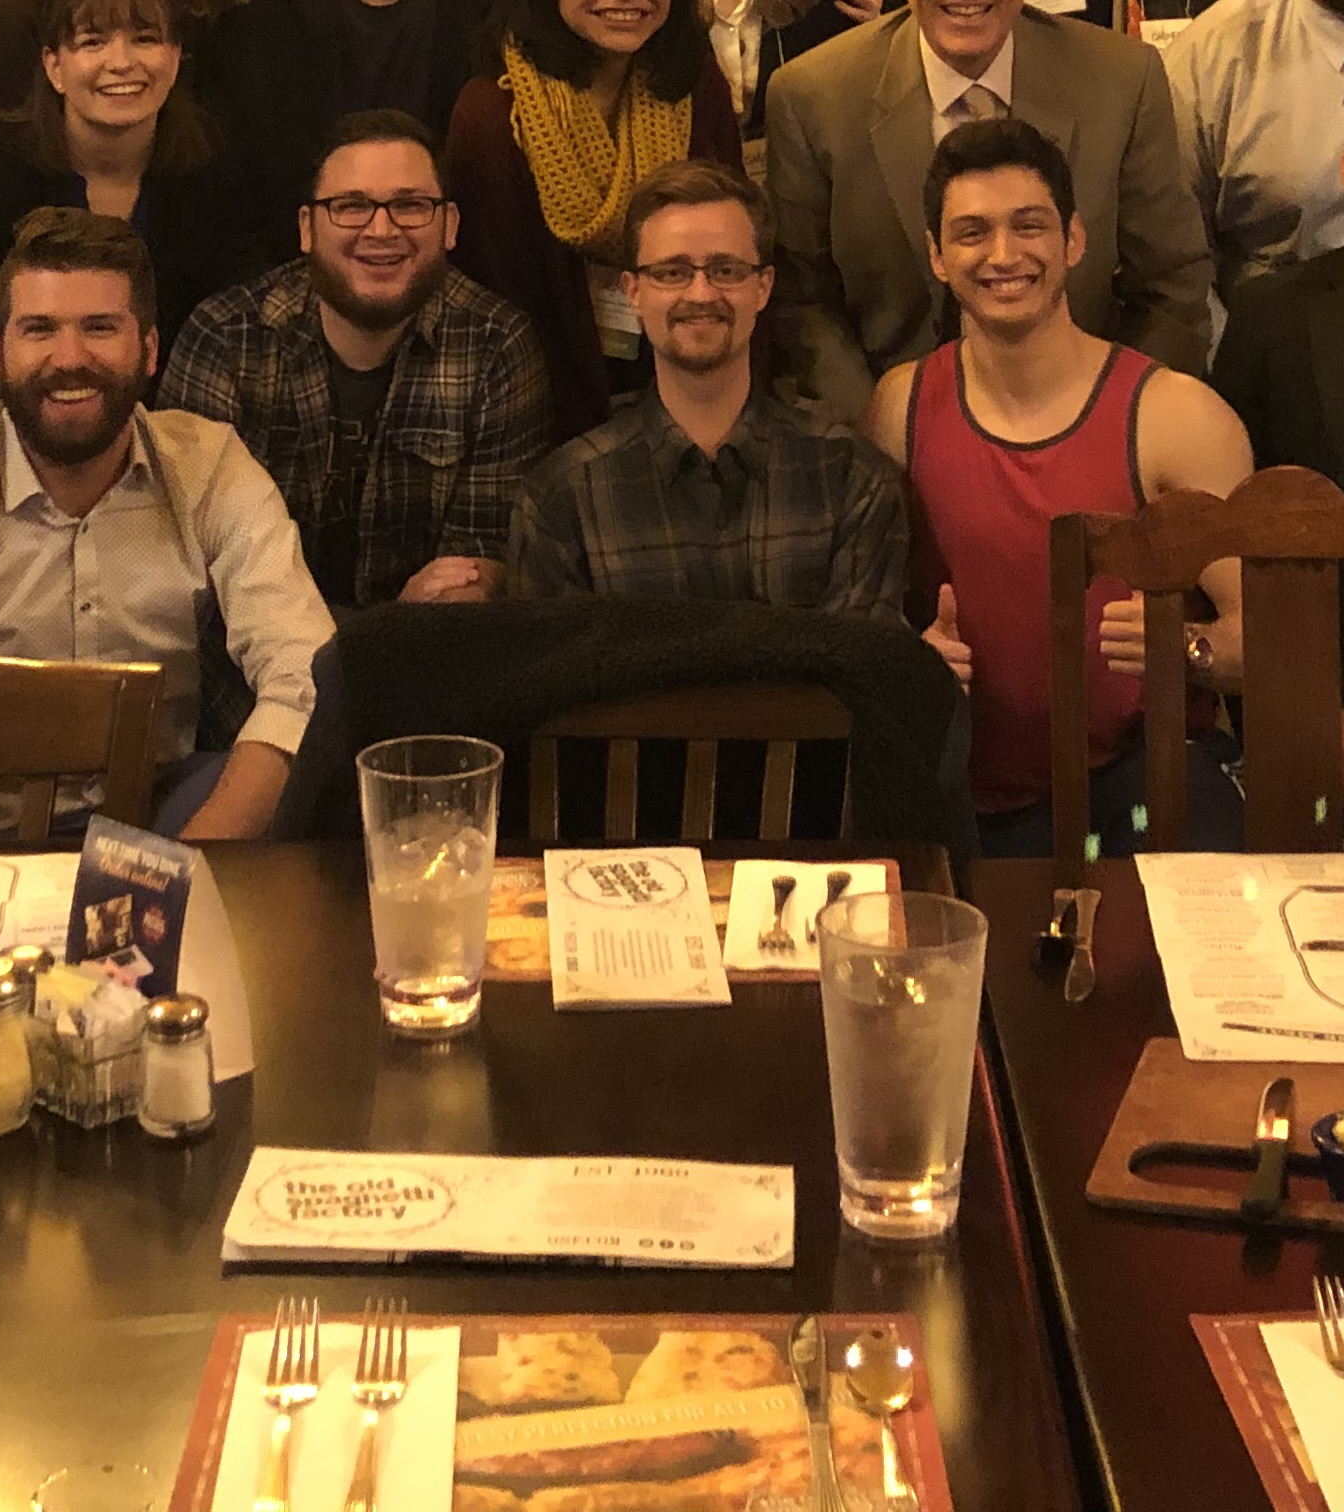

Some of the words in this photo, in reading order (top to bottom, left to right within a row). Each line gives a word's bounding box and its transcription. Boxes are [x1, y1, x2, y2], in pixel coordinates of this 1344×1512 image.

[96, 837, 118, 853] NEXT
[120, 842, 141, 863] TIME
[141, 850, 160, 868] YOU
[286, 1180, 339, 1194] the
[346, 1176, 394, 1192] old
[286, 1186, 435, 1209] spaghetti
[289, 1205, 407, 1221] factory
